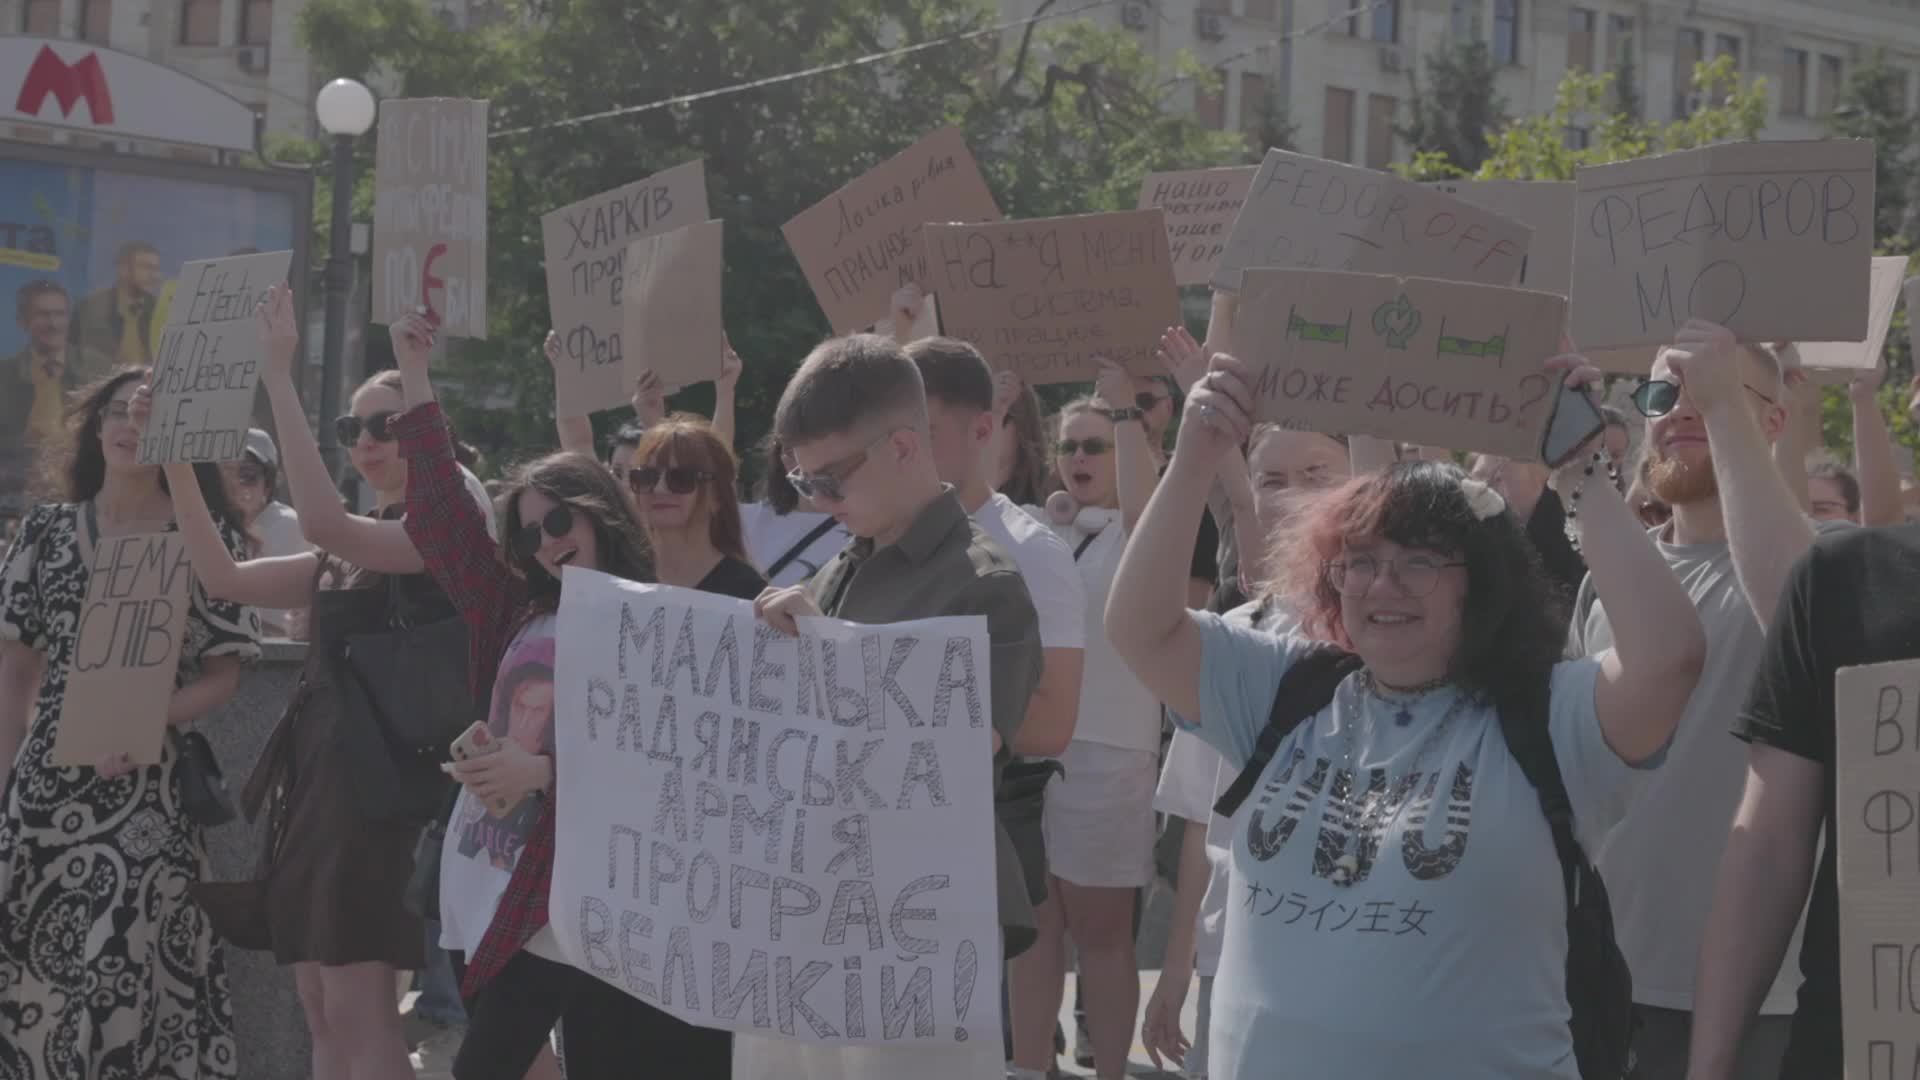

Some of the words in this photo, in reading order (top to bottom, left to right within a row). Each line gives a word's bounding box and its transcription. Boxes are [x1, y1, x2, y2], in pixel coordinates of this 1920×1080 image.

[1423, 211, 1521, 272] OFF
[1589, 173, 1860, 266] ФЕДОРОВ
[1249, 362, 1353, 405] МОЖЕ
[1364, 372, 1551, 430] ДОСИТЬ?
[85, 536, 192, 602] НЕМА
[75, 598, 173, 672] СЛІВ
[586, 674, 953, 811] РАДЯНСЬКА
[653, 756, 875, 879] АРМІЯ
[607, 822, 951, 954] ПРОГРАЄ
[1243, 879, 1434, 936] オンライン王女
[578, 894, 980, 1043] ВЕЛИКІЙ!
